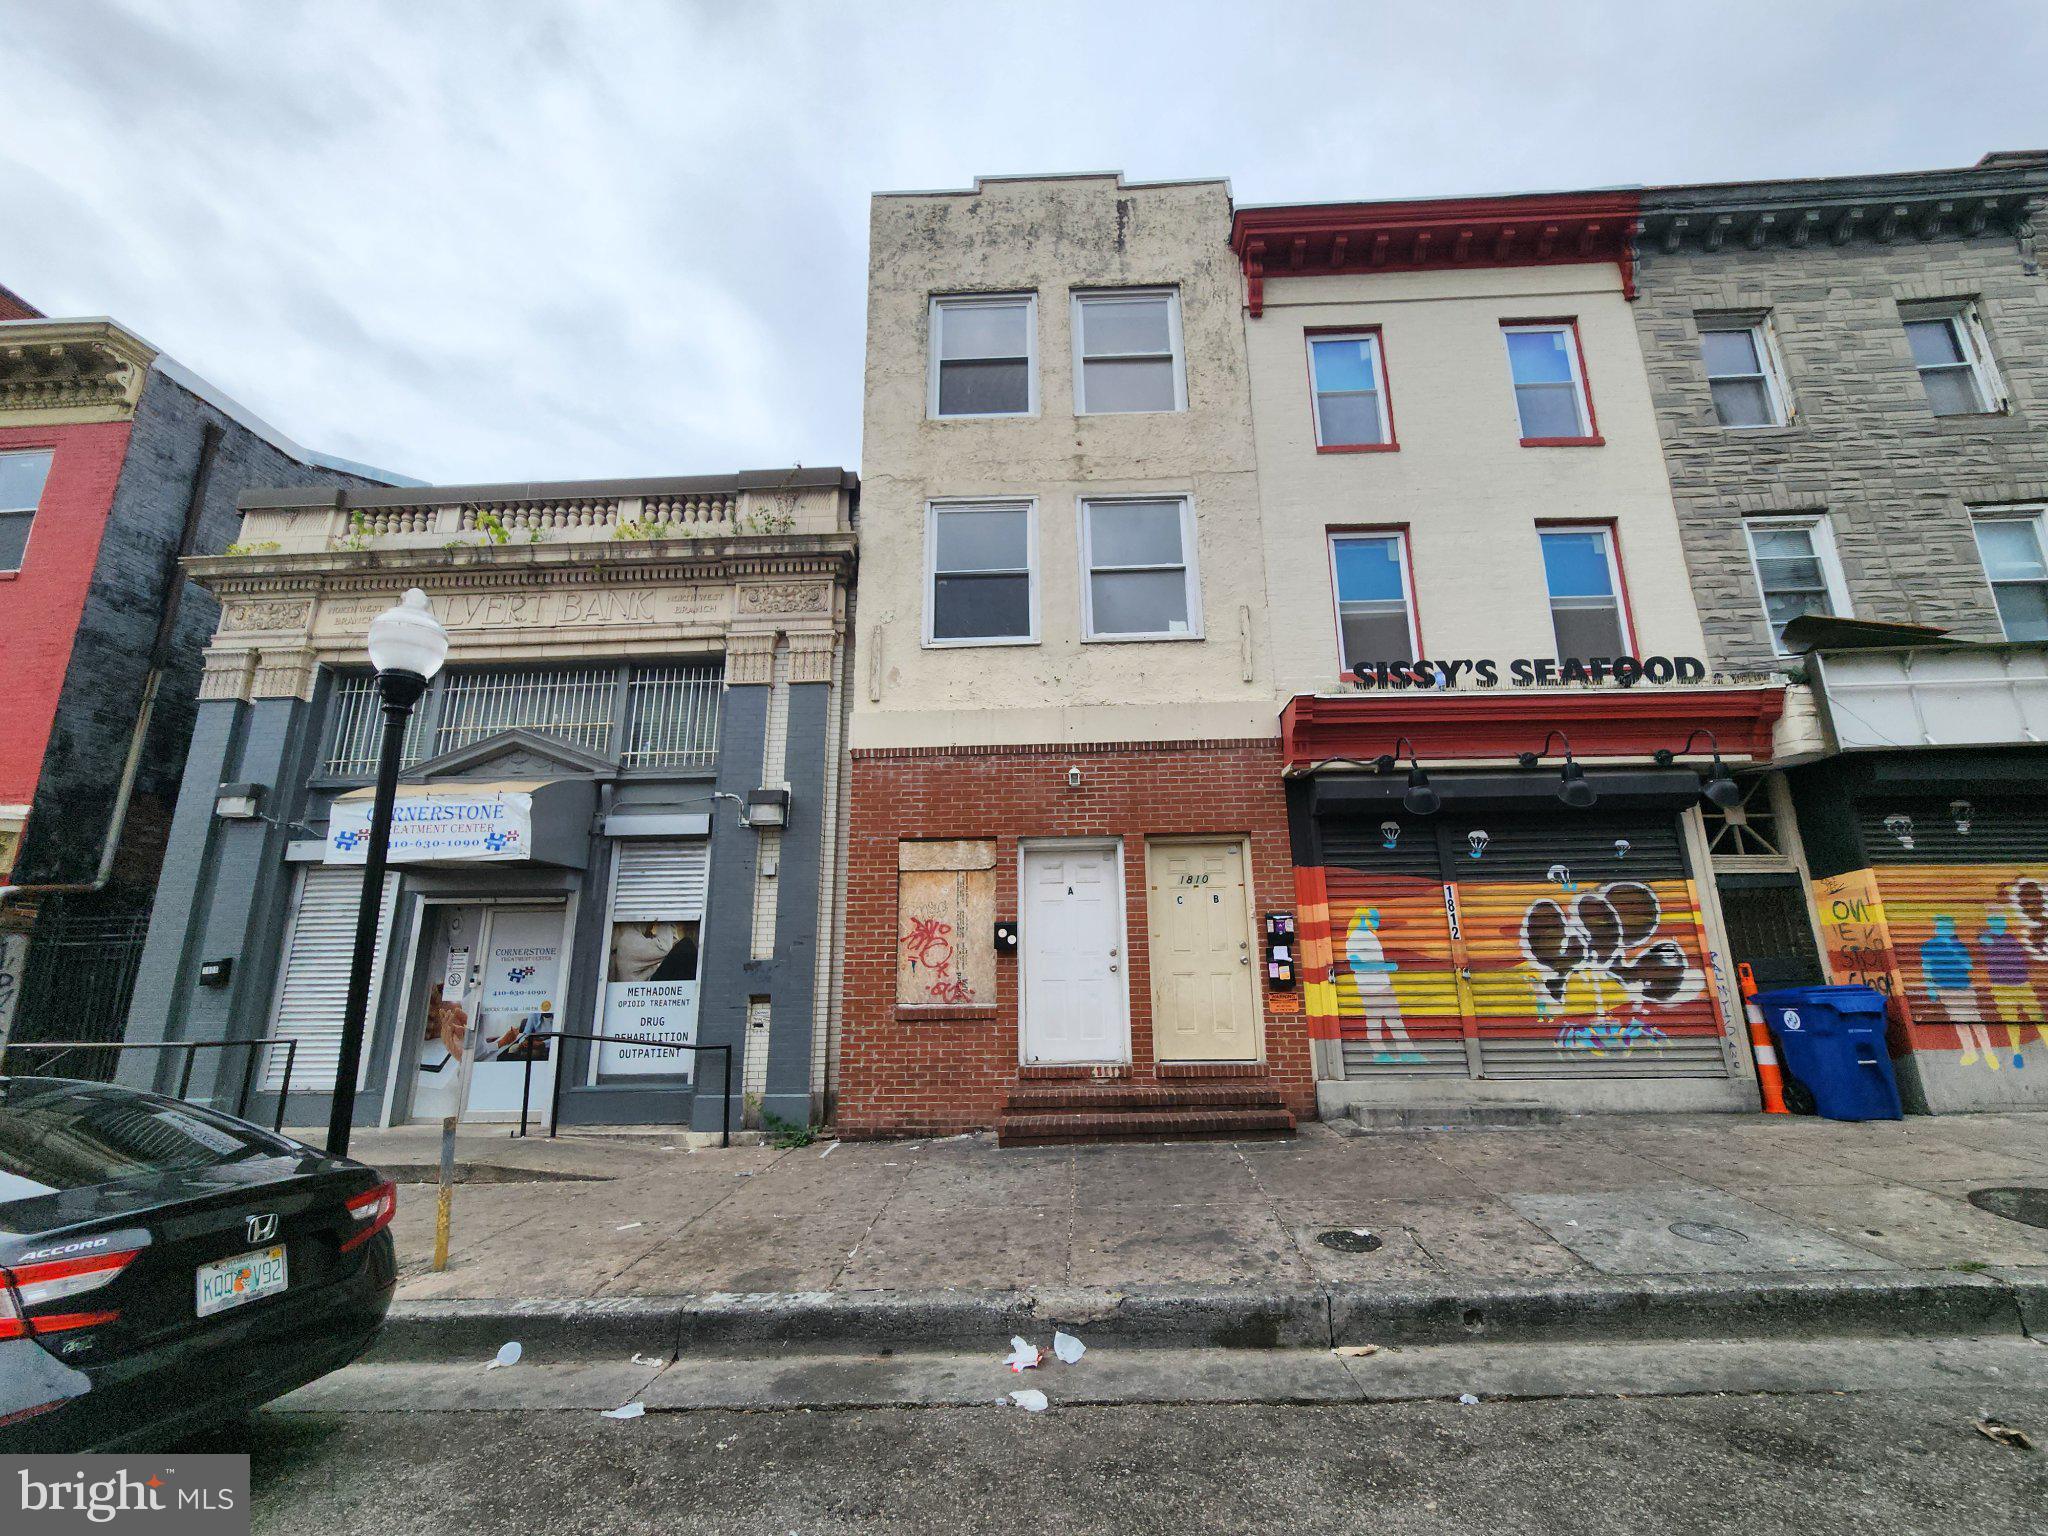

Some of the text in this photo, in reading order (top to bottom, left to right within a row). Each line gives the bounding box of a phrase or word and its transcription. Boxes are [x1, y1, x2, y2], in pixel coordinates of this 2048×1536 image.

[557, 589, 655, 624] BANK
[1353, 660, 1498, 690] SISSY'S
[1510, 656, 1706, 687] SEAFOOD
[450, 823, 495, 833] CENTER
[1180, 875, 1209, 884] 1810
[1067, 887, 1074, 896] A
[1177, 895, 1219, 905] C B
[1446, 886, 1460, 939] 1812
[495, 948, 557, 956] CORNERSTONE
[627, 986, 683, 996] METHADONE
[618, 998, 690, 1008] OPIOID TREATMENT
[640, 1017, 665, 1026] DRUG
[619, 1048, 681, 1059] OUTPATIENT
[17, 1238, 108, 1262] ACCORD
